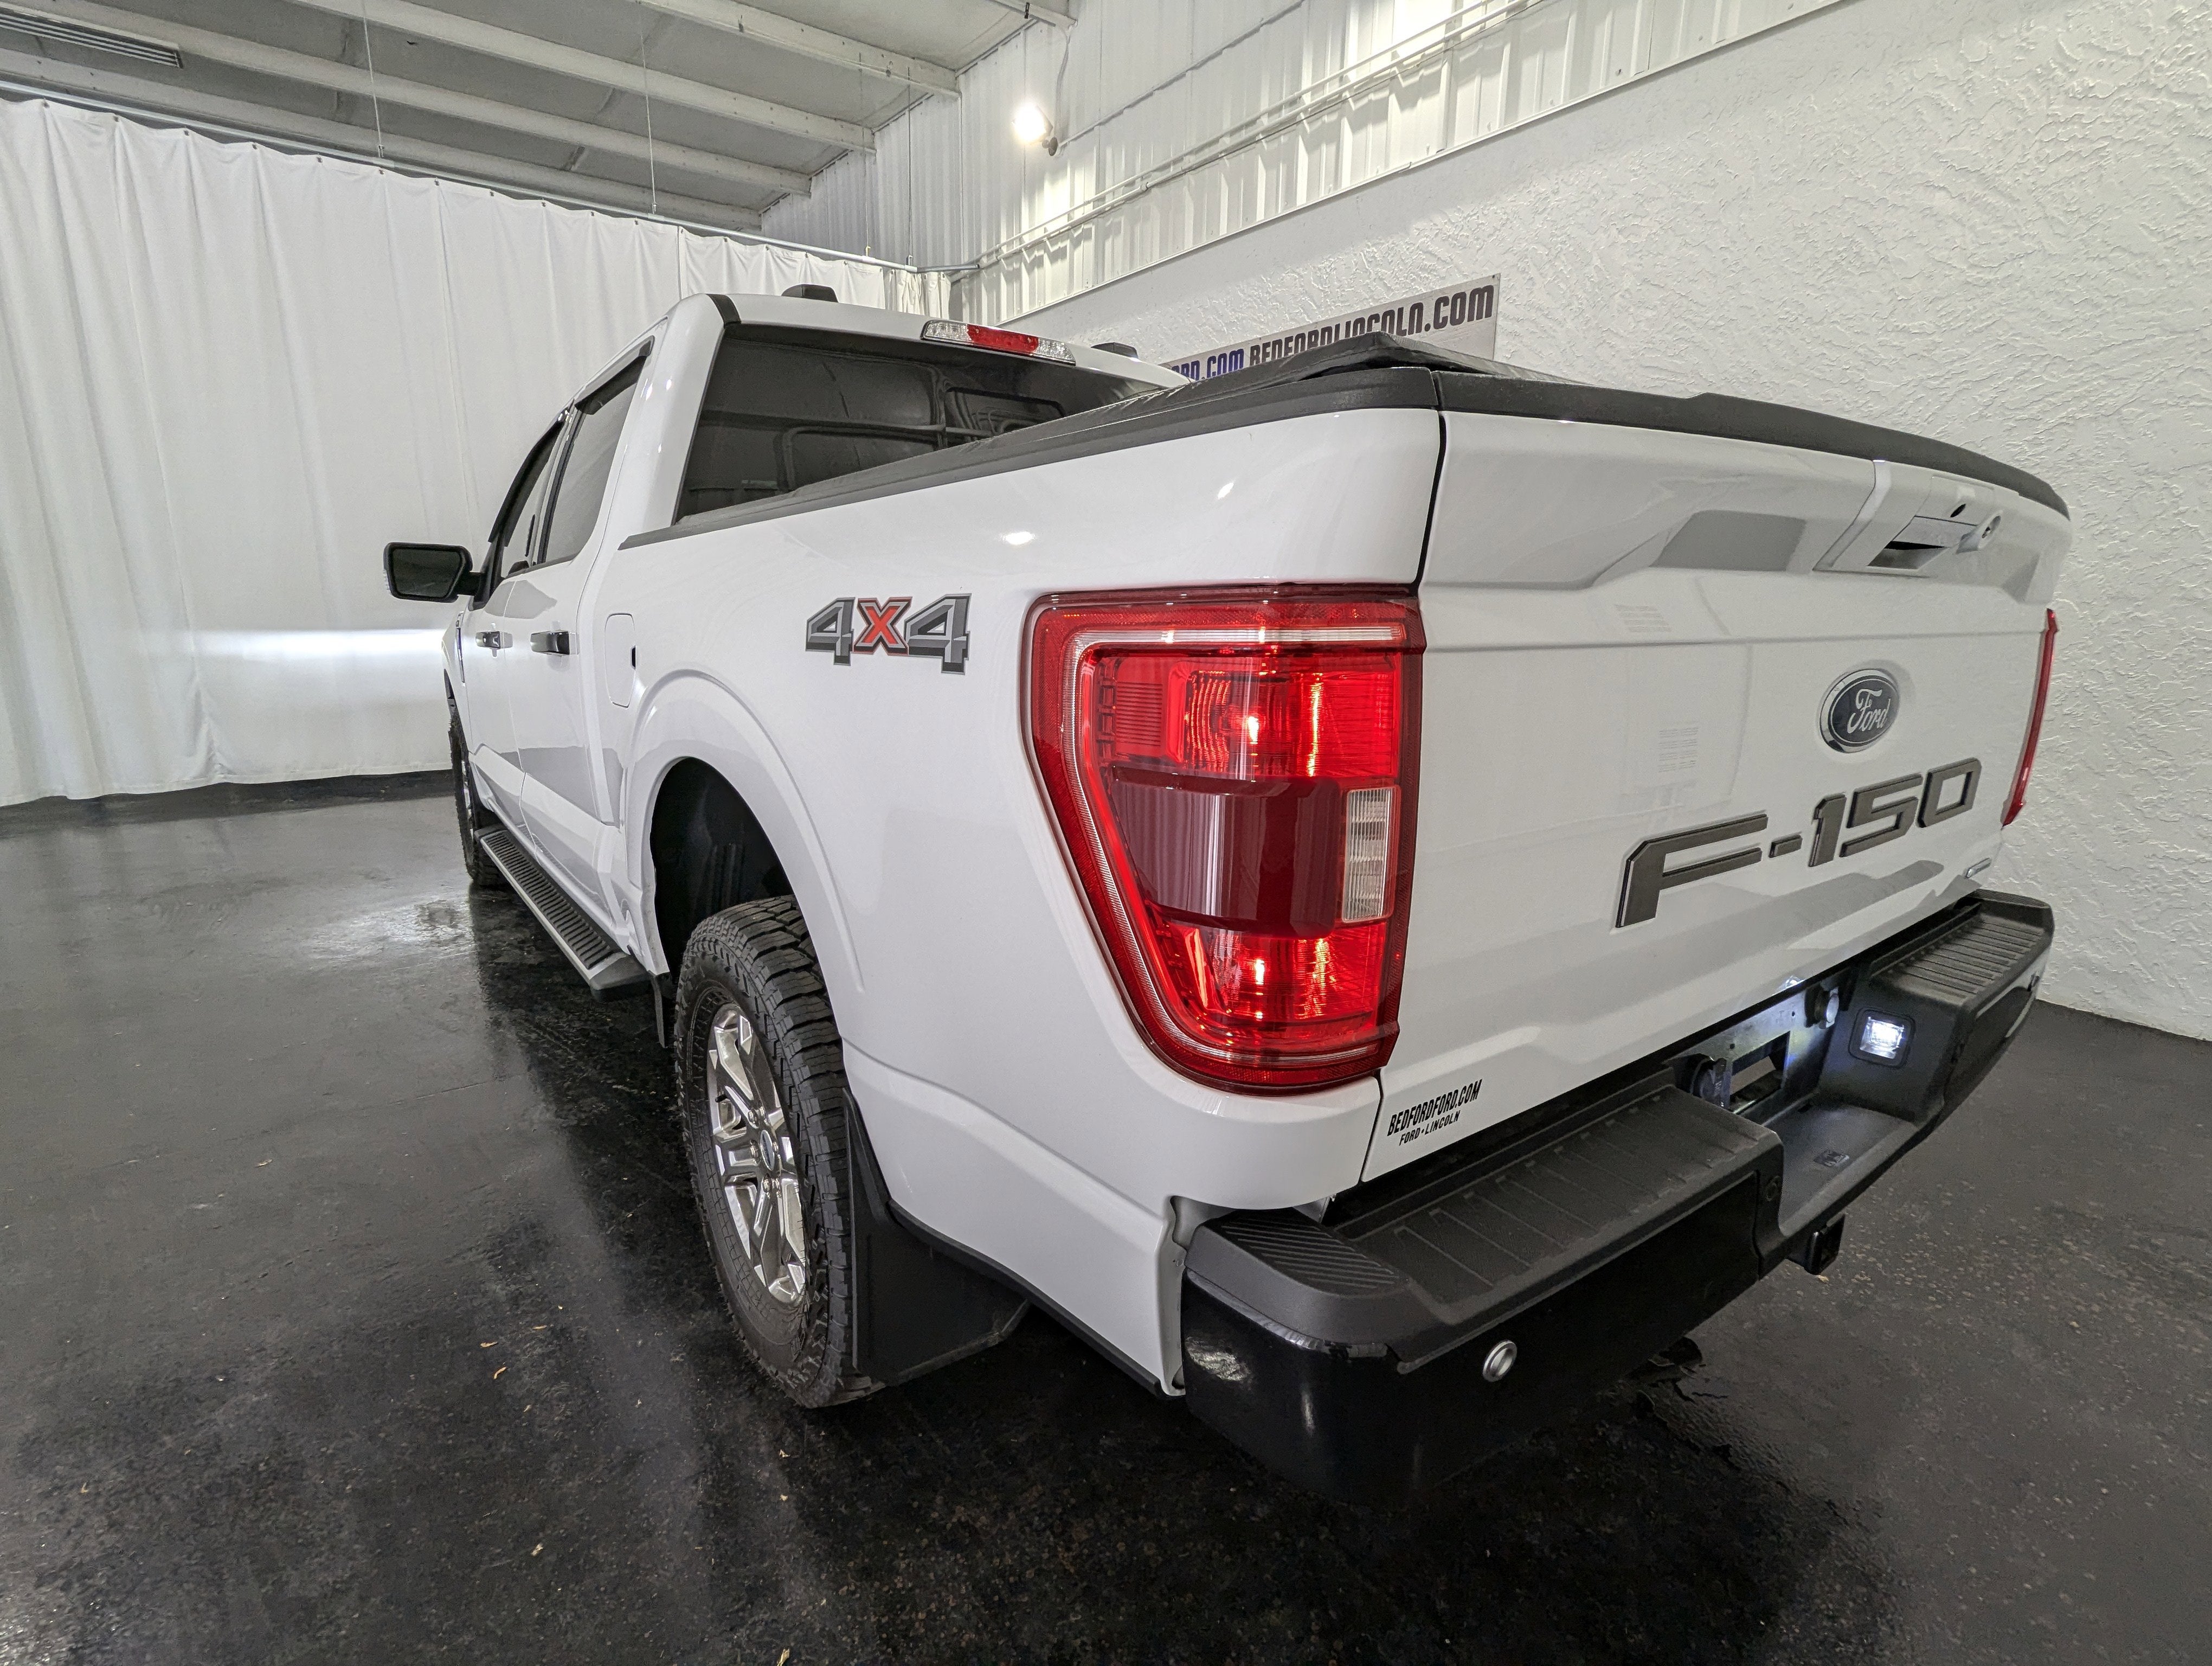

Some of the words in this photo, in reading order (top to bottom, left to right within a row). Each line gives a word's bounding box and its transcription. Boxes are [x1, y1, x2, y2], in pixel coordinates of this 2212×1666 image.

[1847, 688, 1891, 734] Ford
[1616, 757, 1982, 928] F-150
[1387, 1079, 1483, 1137] BEDFORDFORD.COM
